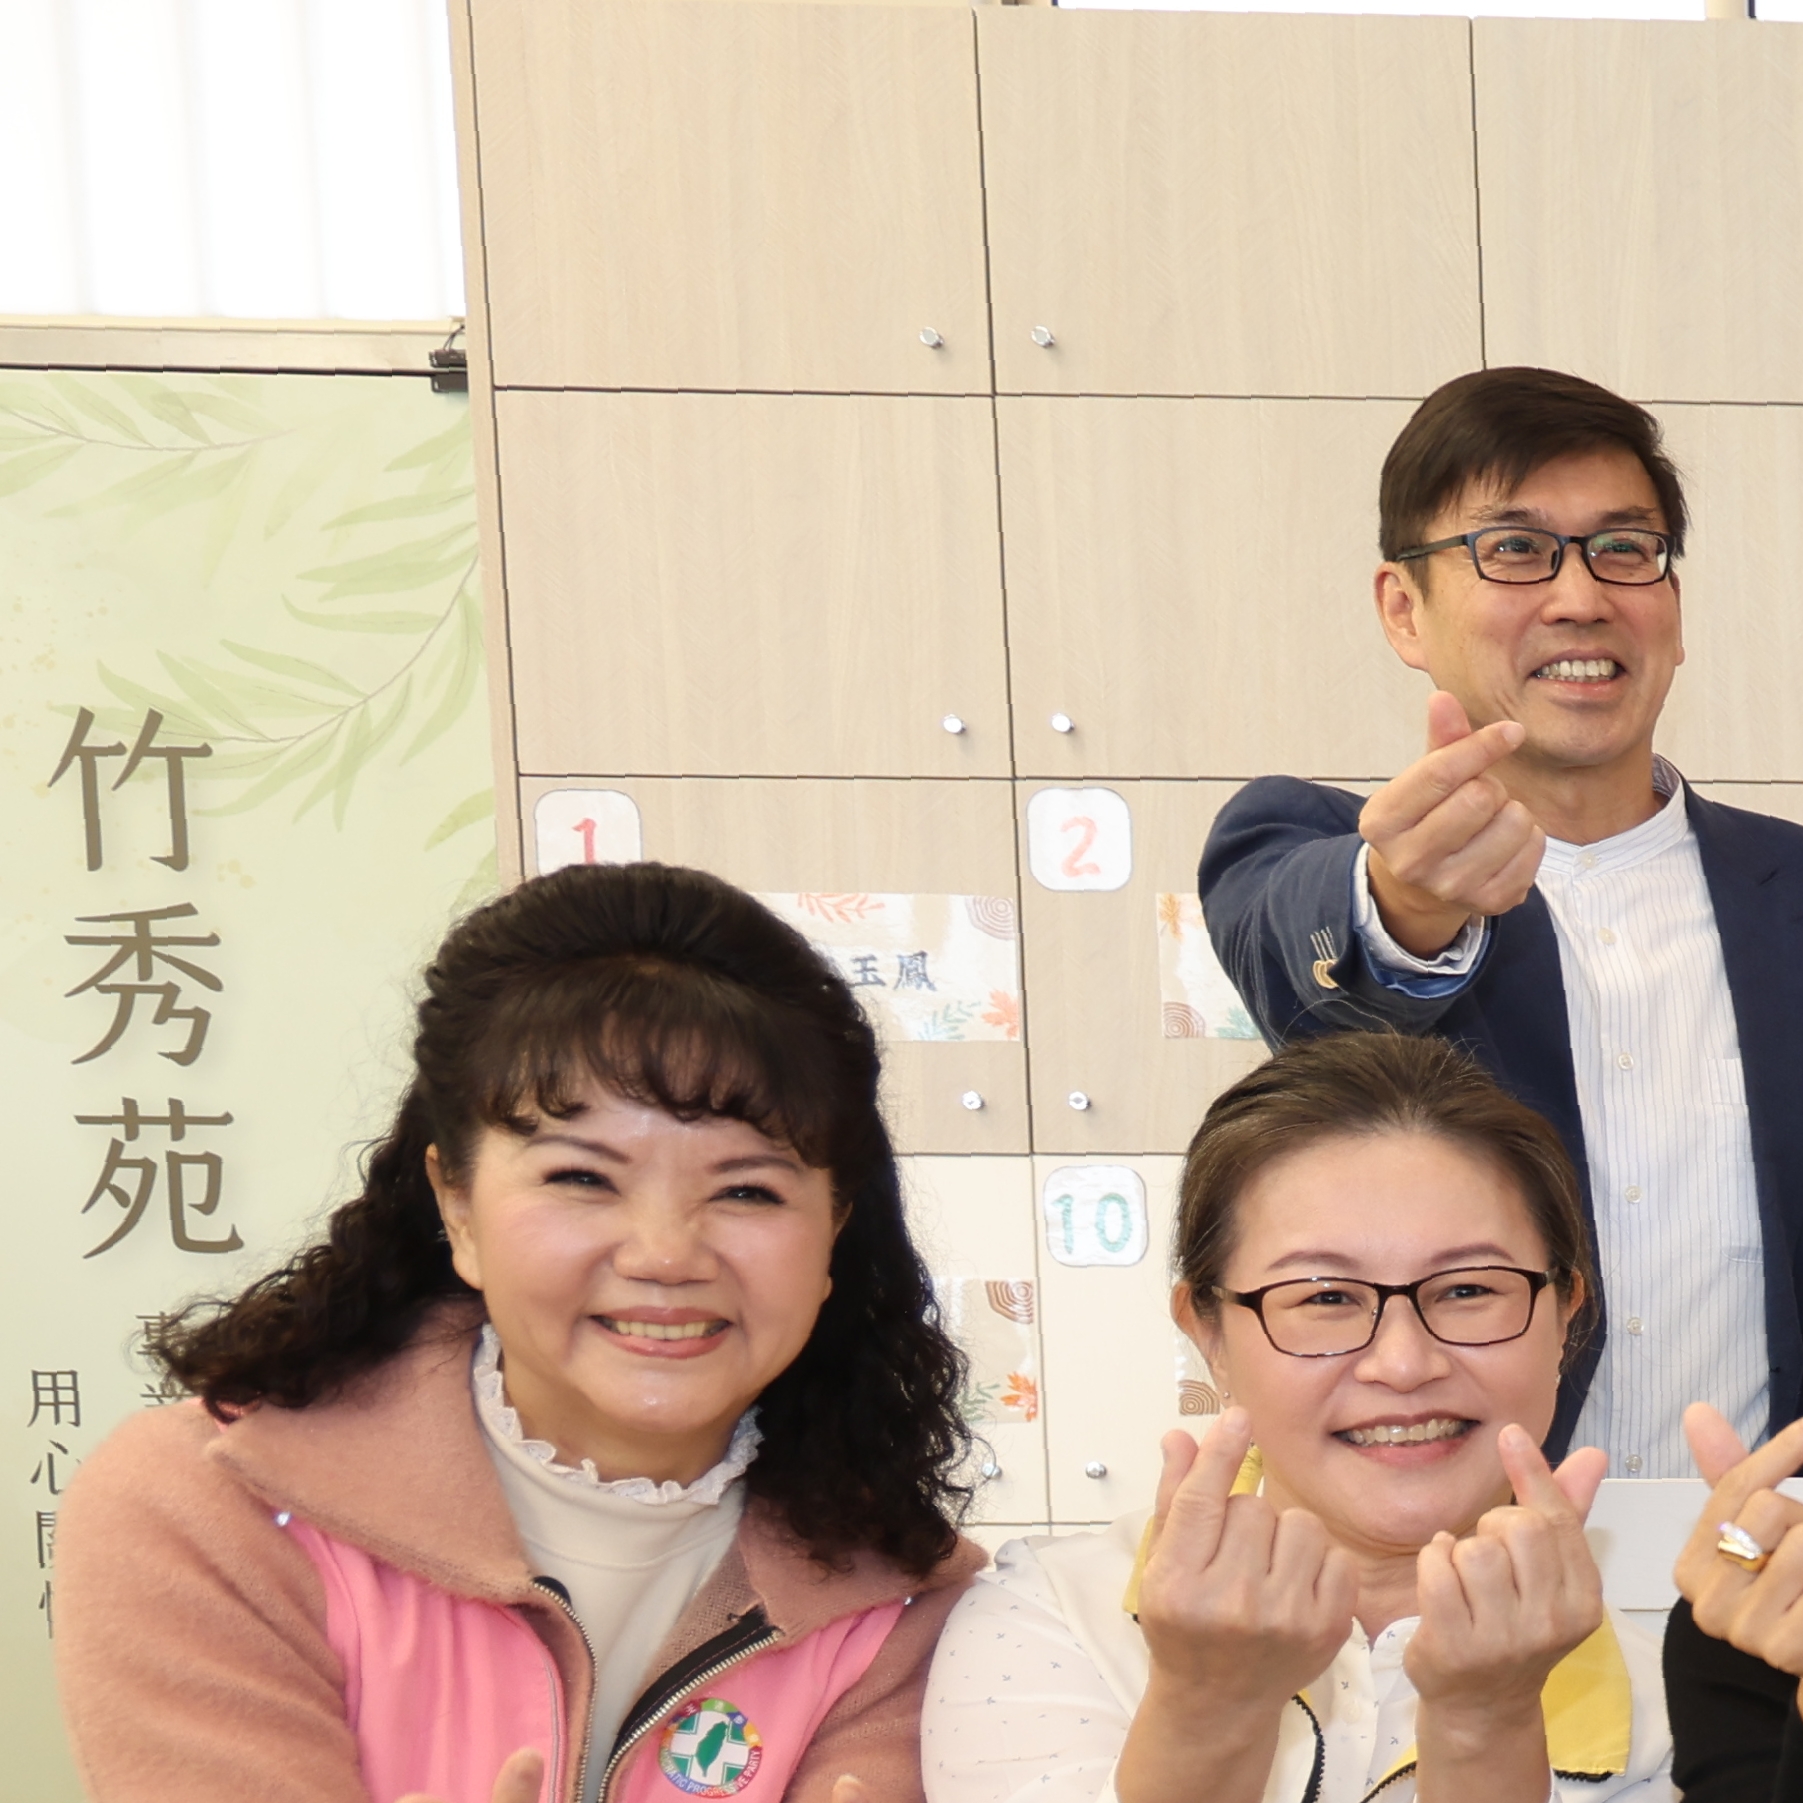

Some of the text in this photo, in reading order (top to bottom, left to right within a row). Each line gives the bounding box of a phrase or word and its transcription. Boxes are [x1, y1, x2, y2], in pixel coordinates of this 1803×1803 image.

[571, 817, 597, 865] 1
[1060, 816, 1100, 878] 2
[47, 707, 243, 1259] 竹秀苑
[1050, 1192, 1132, 1255] 10
